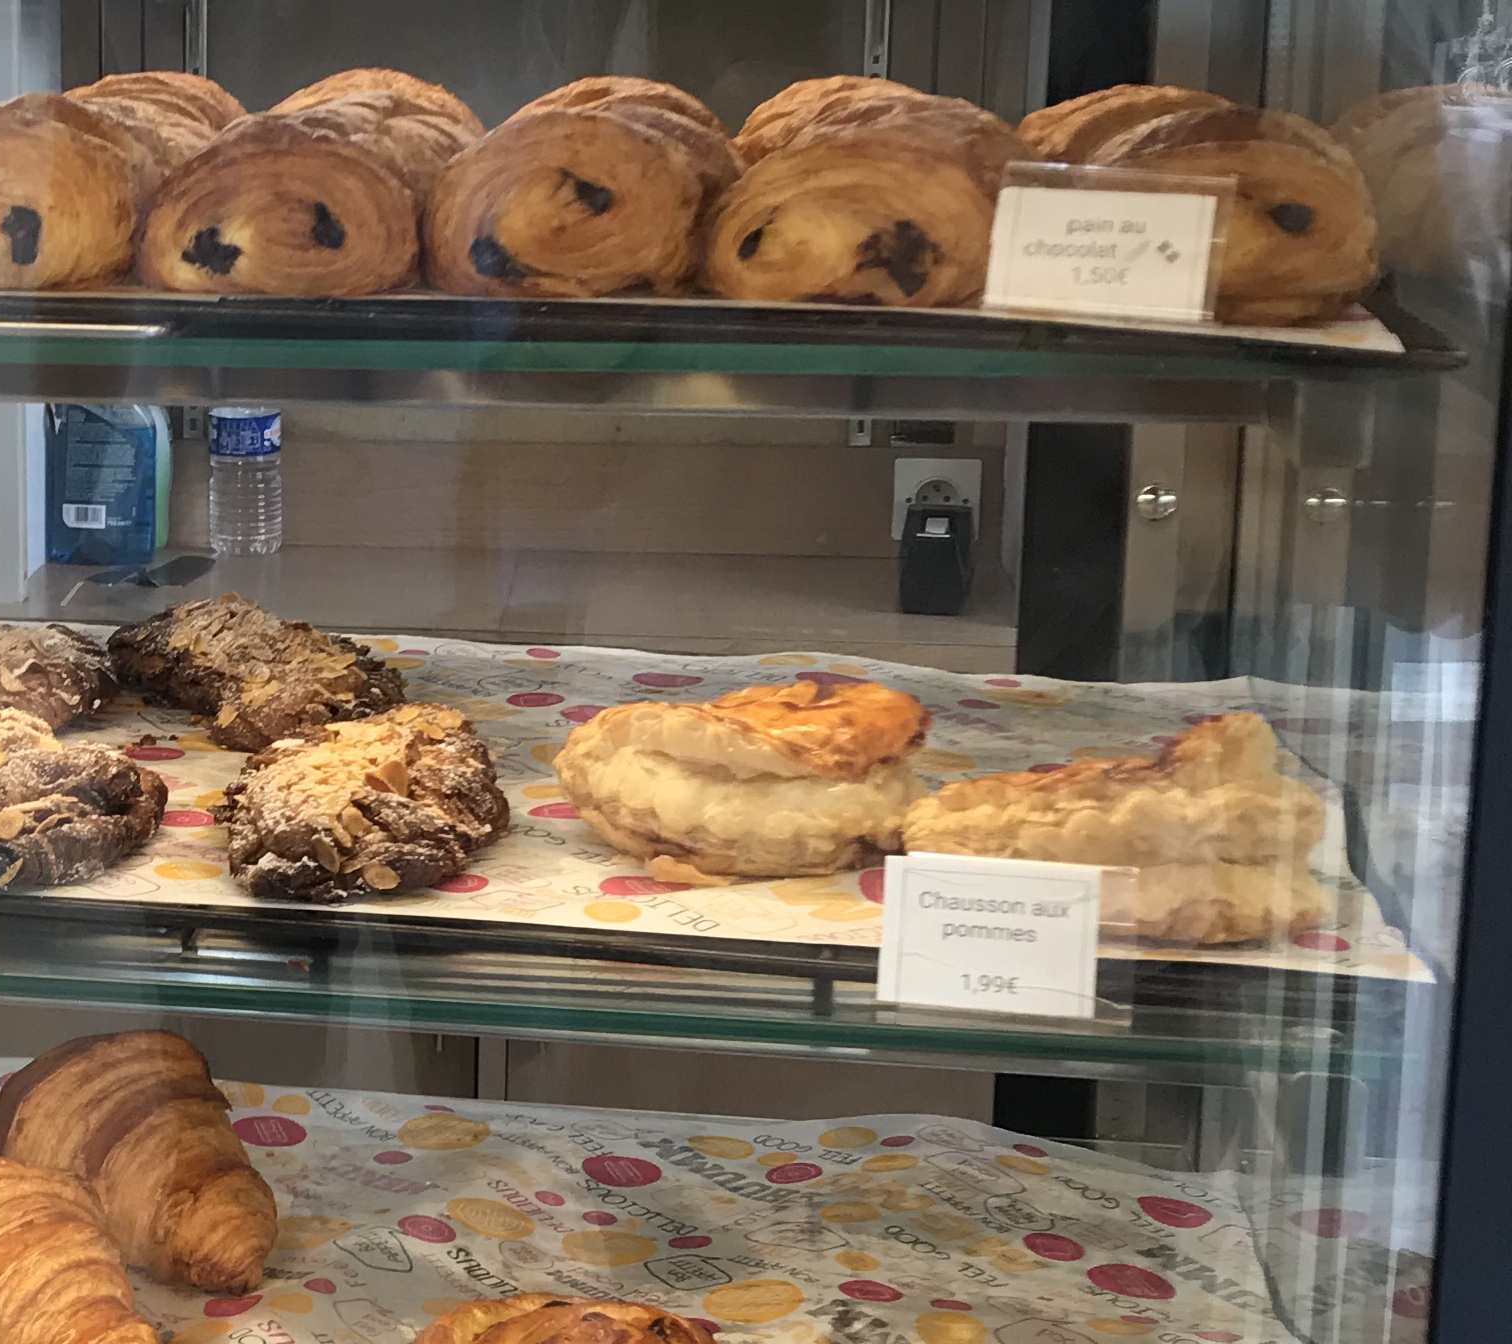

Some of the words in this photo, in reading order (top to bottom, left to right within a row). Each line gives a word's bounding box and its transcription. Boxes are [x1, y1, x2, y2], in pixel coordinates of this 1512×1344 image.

[1065, 219, 1114, 235] pain
[1119, 220, 1147, 234] au
[1023, 239, 1118, 258] chocolat
[918, 890, 1027, 915] Chausson
[1031, 901, 1071, 919] aux
[942, 922, 1038, 943] pommes
[960, 973, 1020, 995] 1,99€
